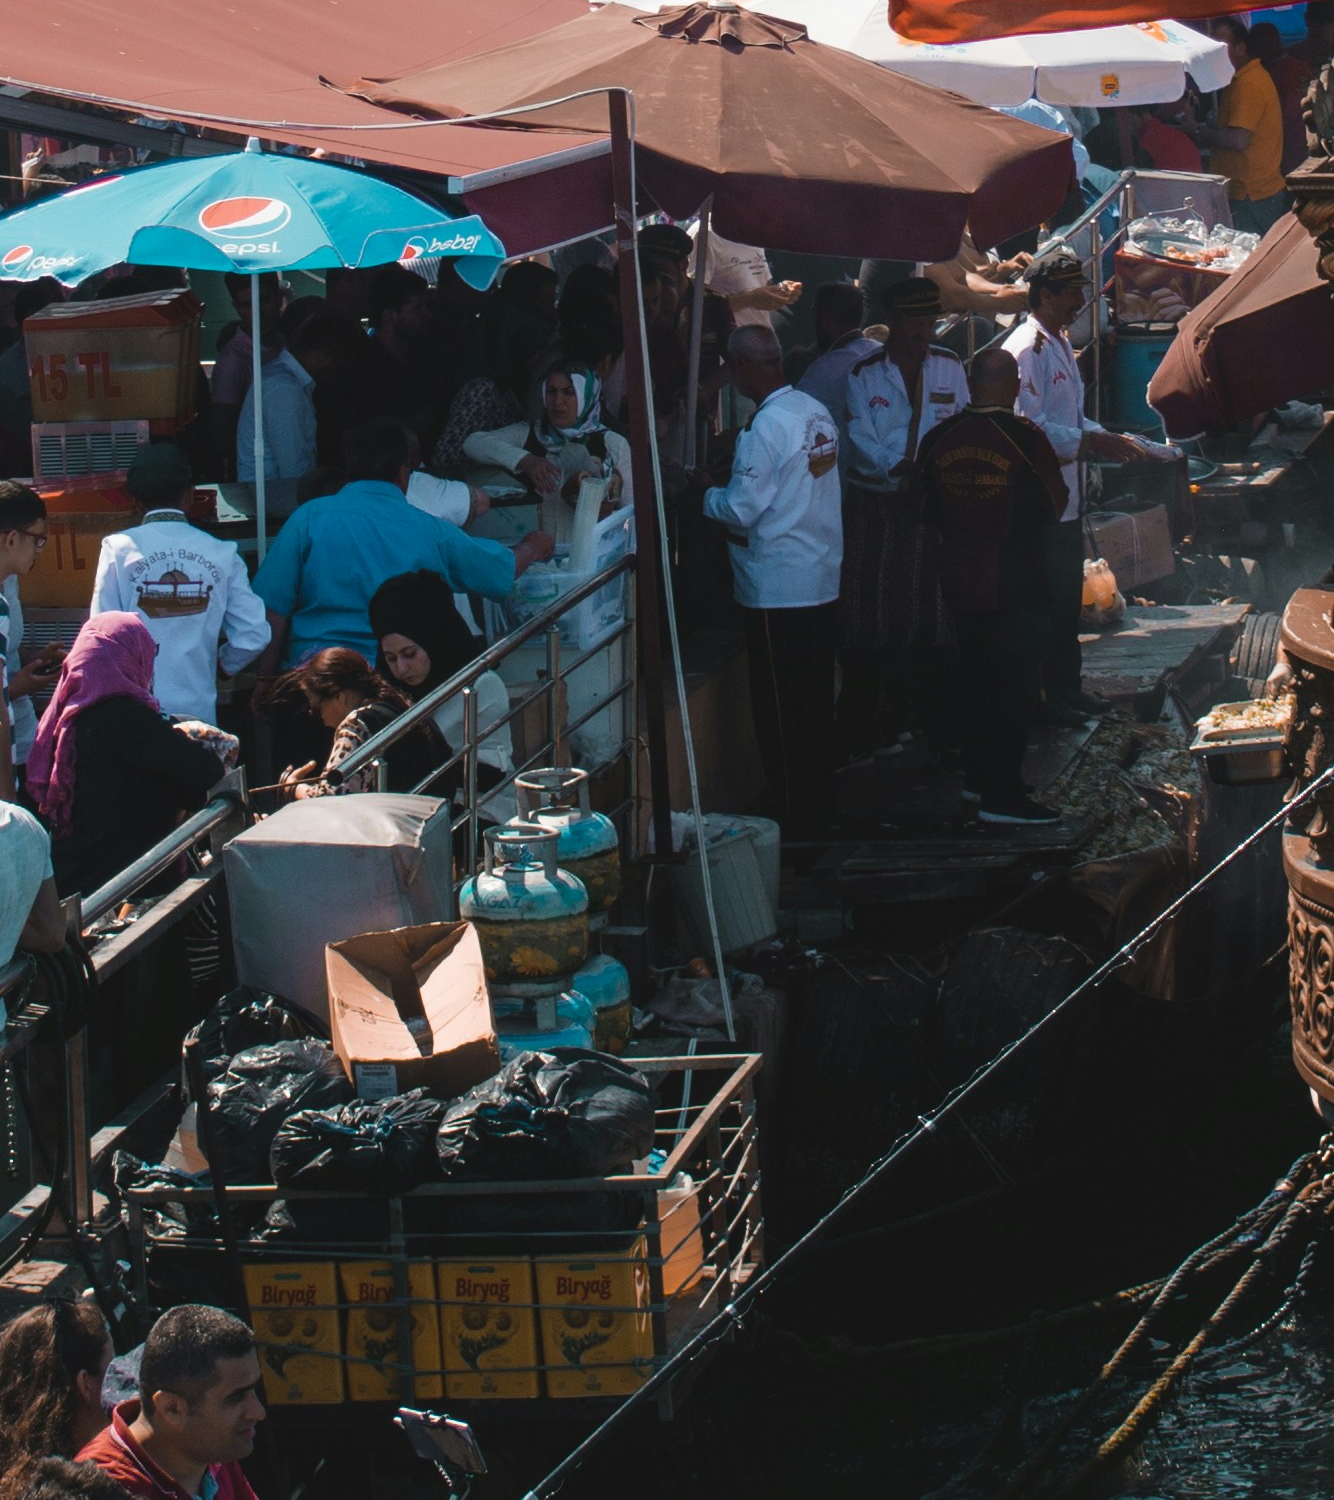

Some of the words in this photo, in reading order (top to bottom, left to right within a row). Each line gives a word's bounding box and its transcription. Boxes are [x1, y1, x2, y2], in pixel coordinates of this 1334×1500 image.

[222, 241, 279, 256] epsi
[79, 352, 123, 400] TL
[50, 522, 86, 570] TL
[261, 1282, 318, 1307] Biryağ
[456, 1277, 511, 1304] Biryağ
[557, 1275, 611, 1301] Biryağ
